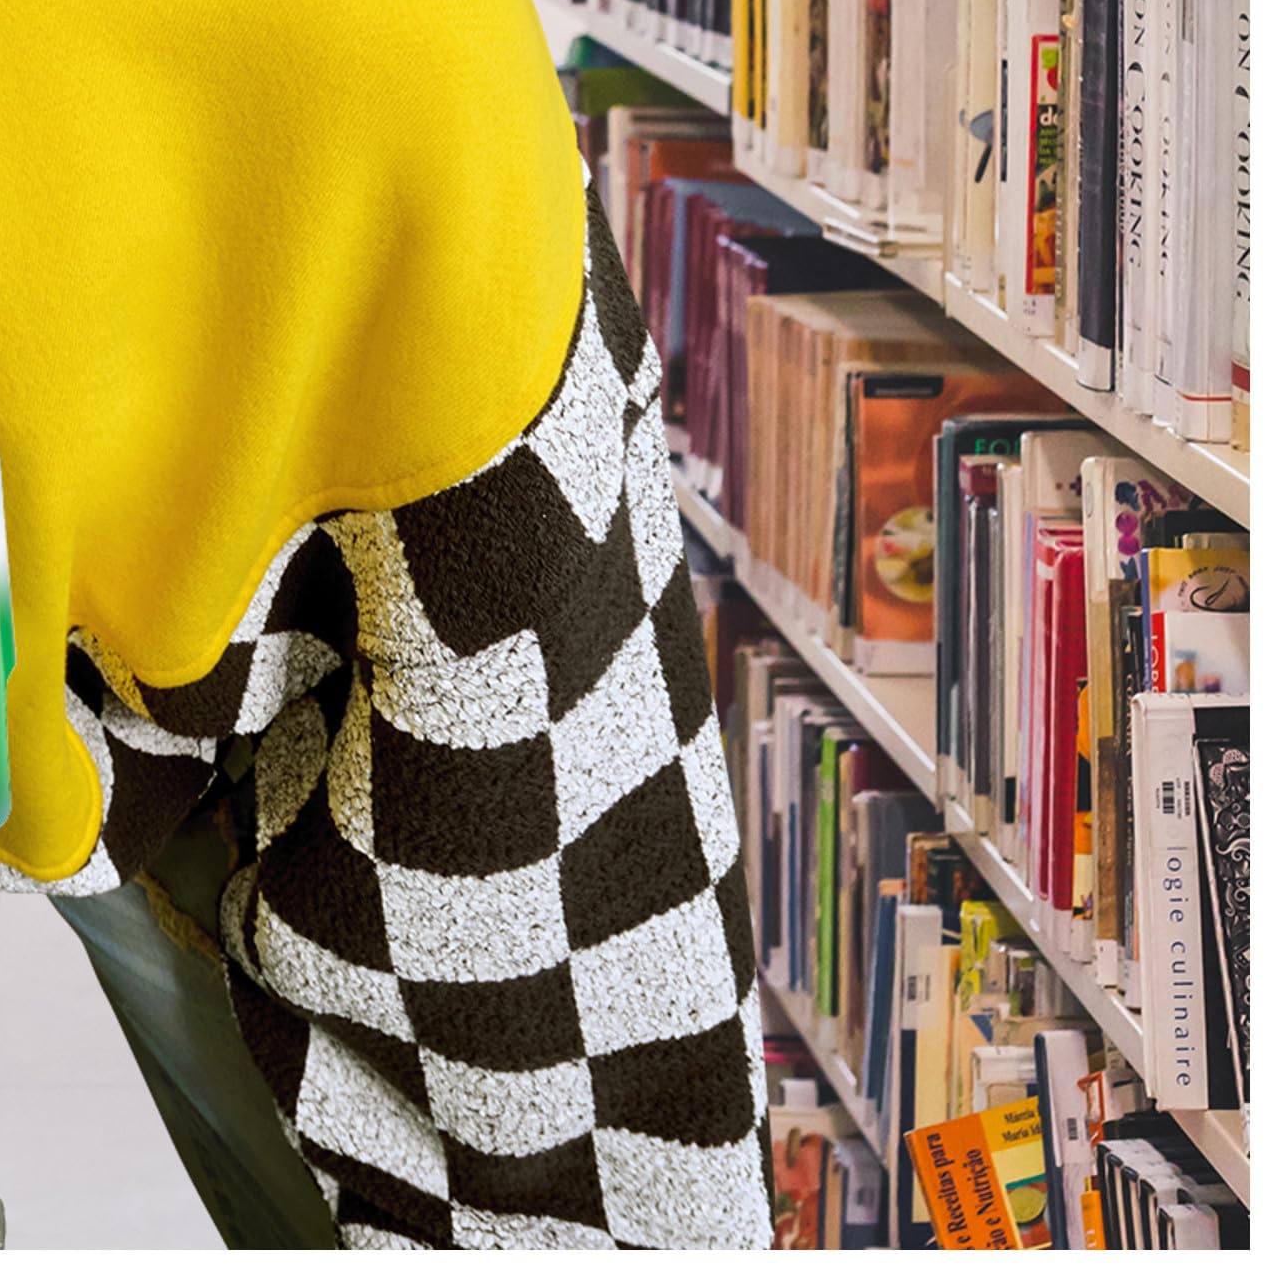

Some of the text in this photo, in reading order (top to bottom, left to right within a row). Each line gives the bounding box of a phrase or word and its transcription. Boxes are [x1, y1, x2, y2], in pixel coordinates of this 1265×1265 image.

[1170, 941, 1195, 1087] culinaire
[926, 1132, 955, 1169] para
[962, 1148, 995, 1216] Nutrição
[938, 1170, 968, 1233] Receitas
[986, 1217, 1001, 1226] e
